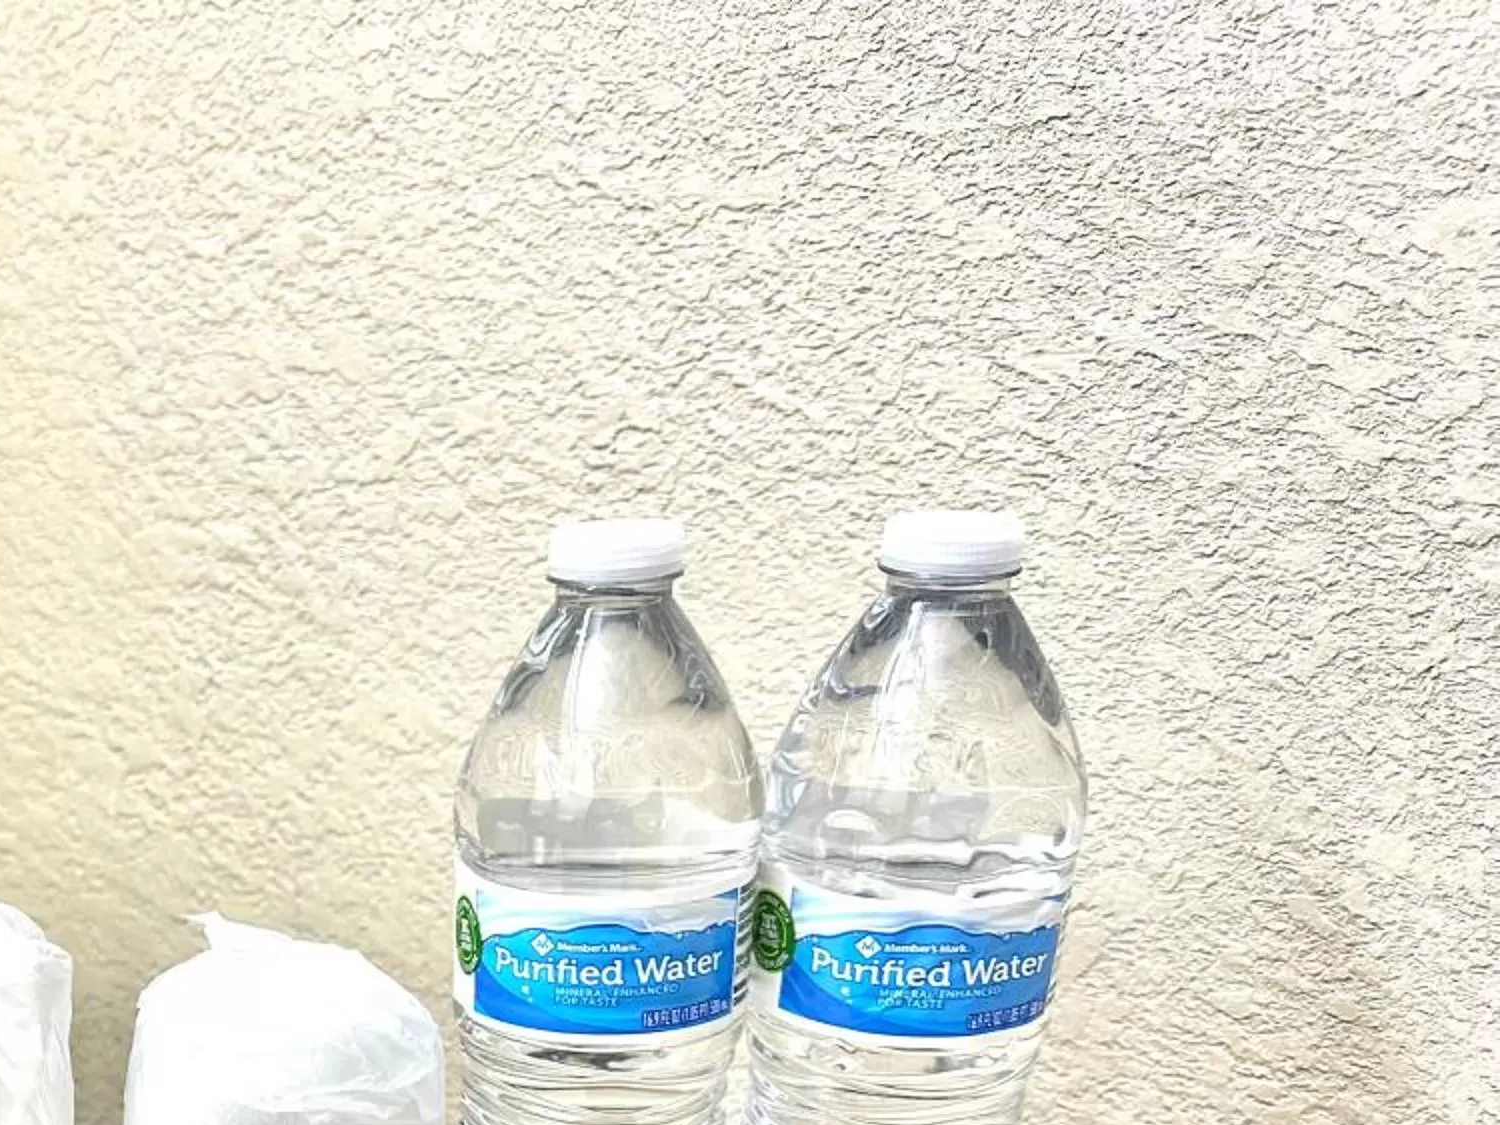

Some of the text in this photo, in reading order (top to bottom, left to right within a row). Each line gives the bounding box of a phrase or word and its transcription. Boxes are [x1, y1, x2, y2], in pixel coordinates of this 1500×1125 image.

[495, 946, 723, 986] Purified Water
[811, 948, 1049, 988] Purified Water
